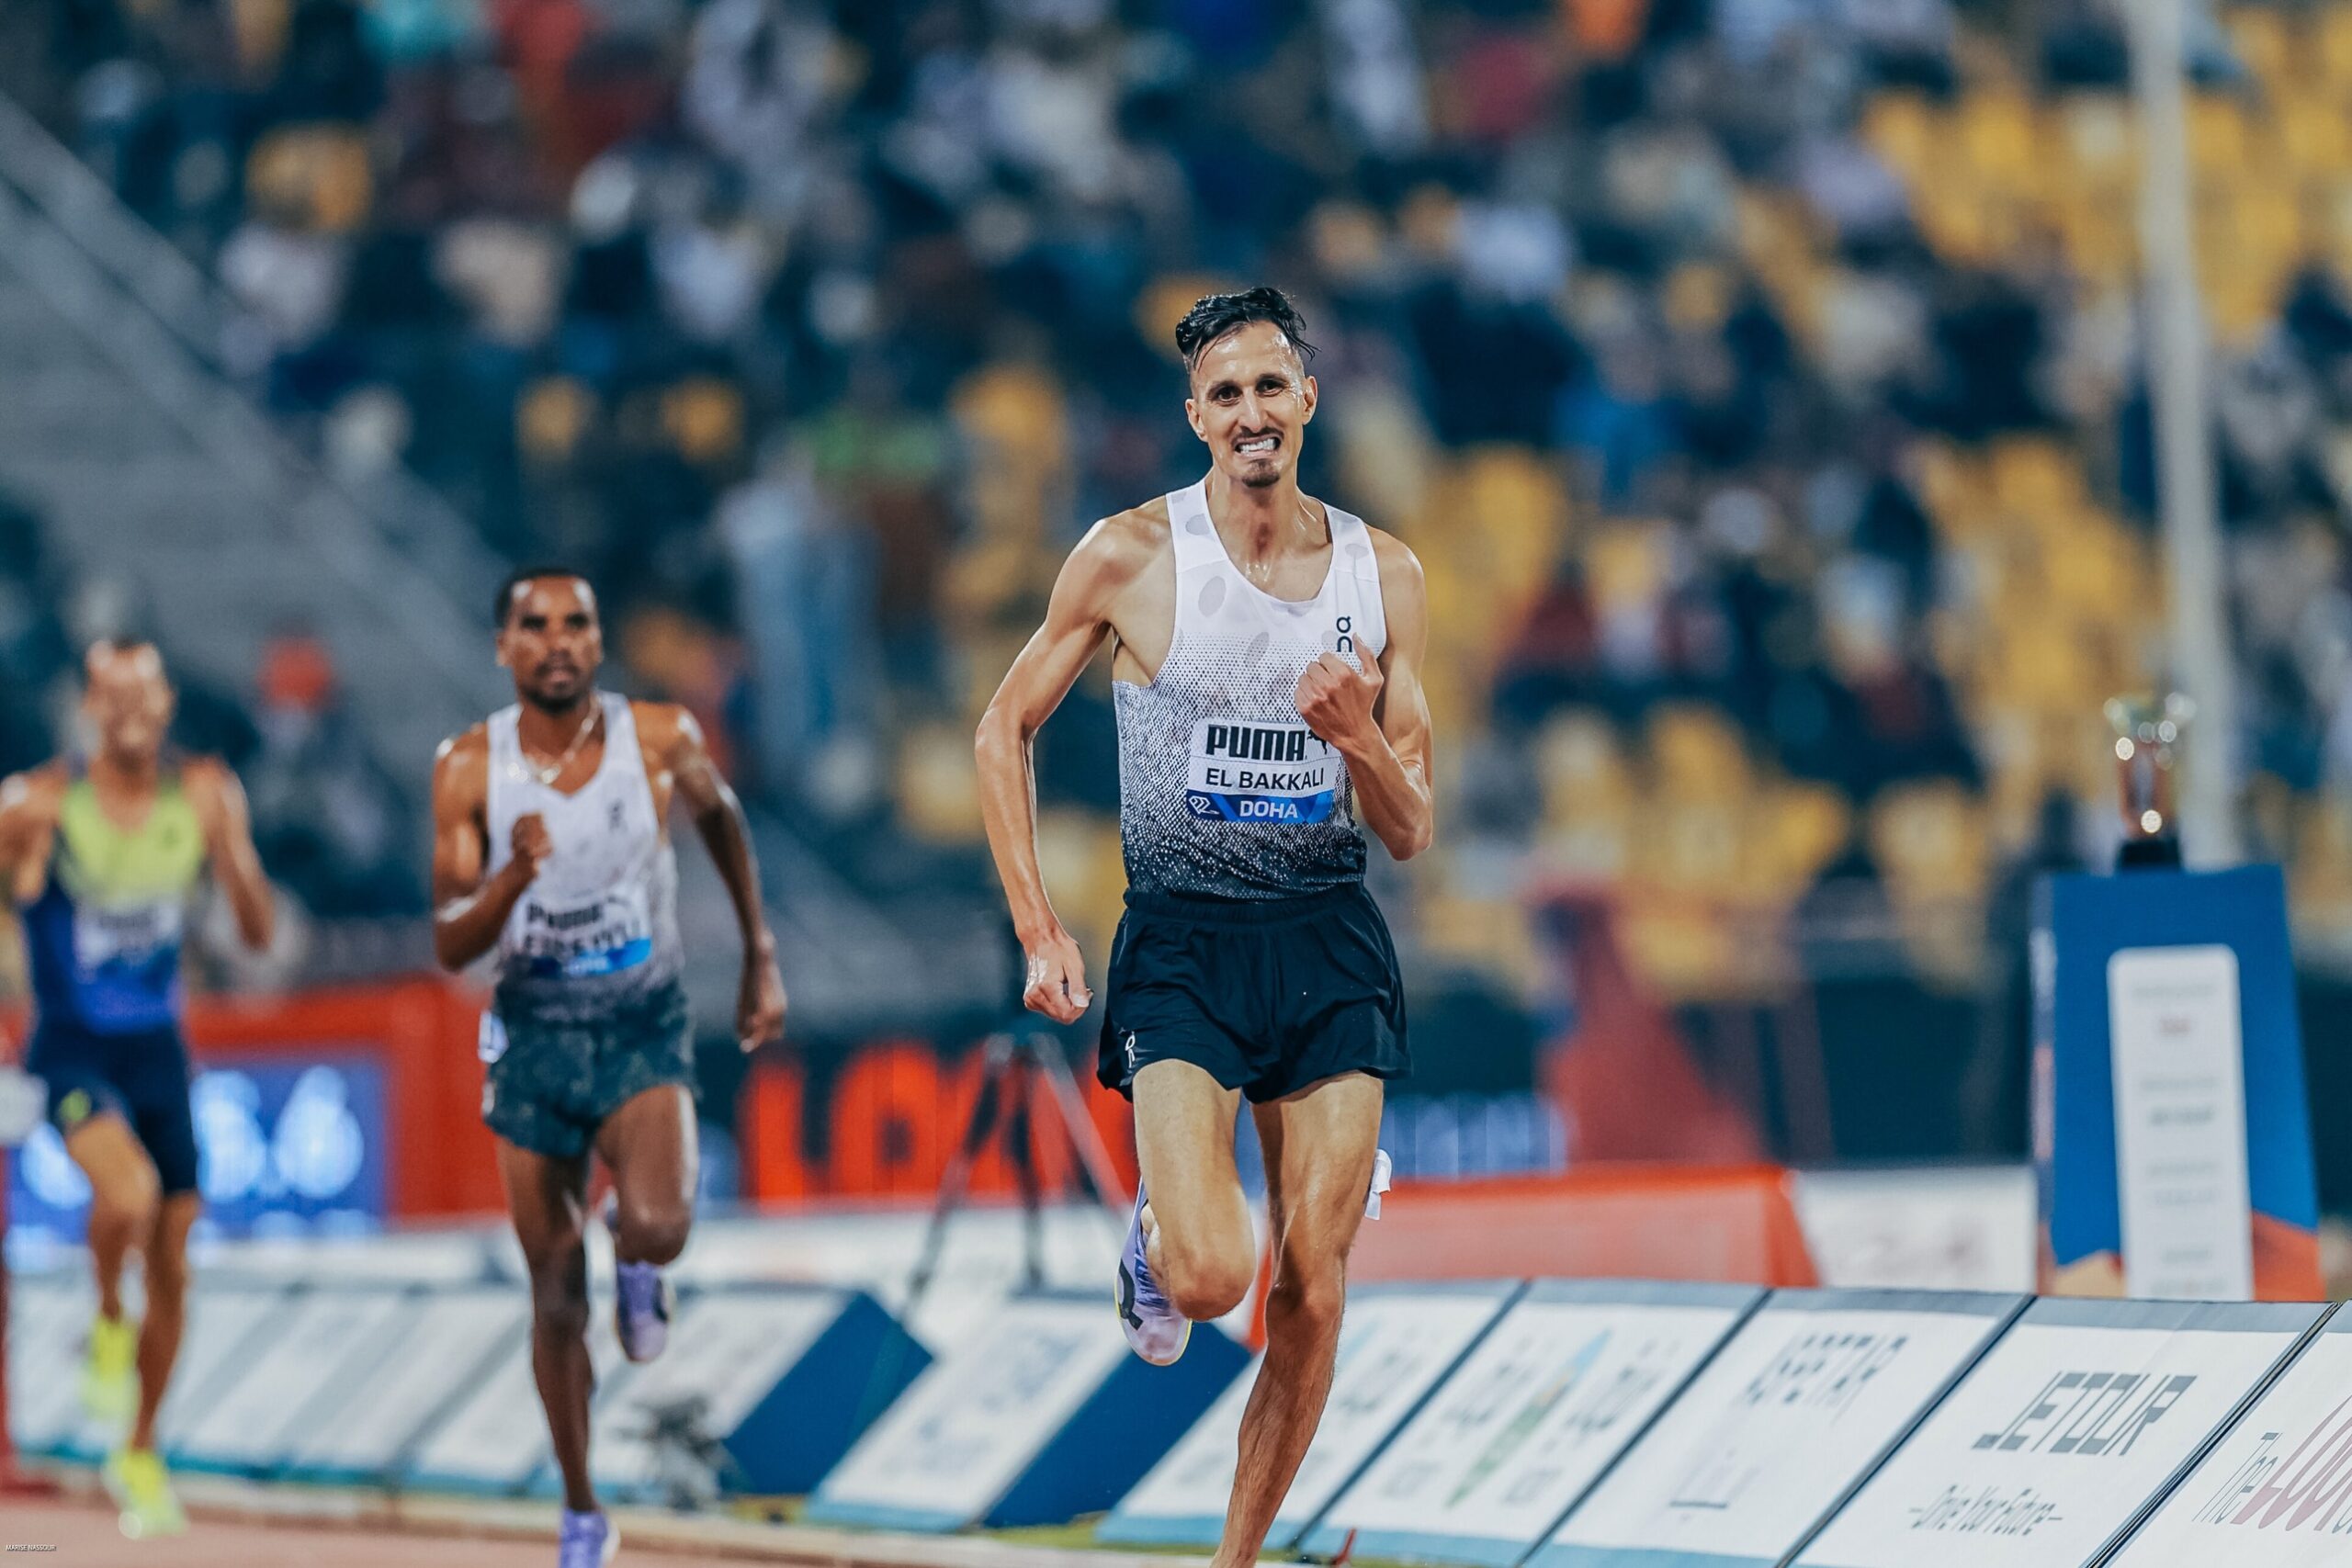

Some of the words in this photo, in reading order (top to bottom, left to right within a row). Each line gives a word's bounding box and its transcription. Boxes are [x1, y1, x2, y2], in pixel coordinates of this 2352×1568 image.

[1205, 723, 1306, 762] PUMA
[1205, 767, 1233, 788] EL
[1238, 767, 1325, 791] BAKKALI
[1239, 800, 1299, 819] DOHA
[1971, 1371, 2198, 1457] JETOUR
